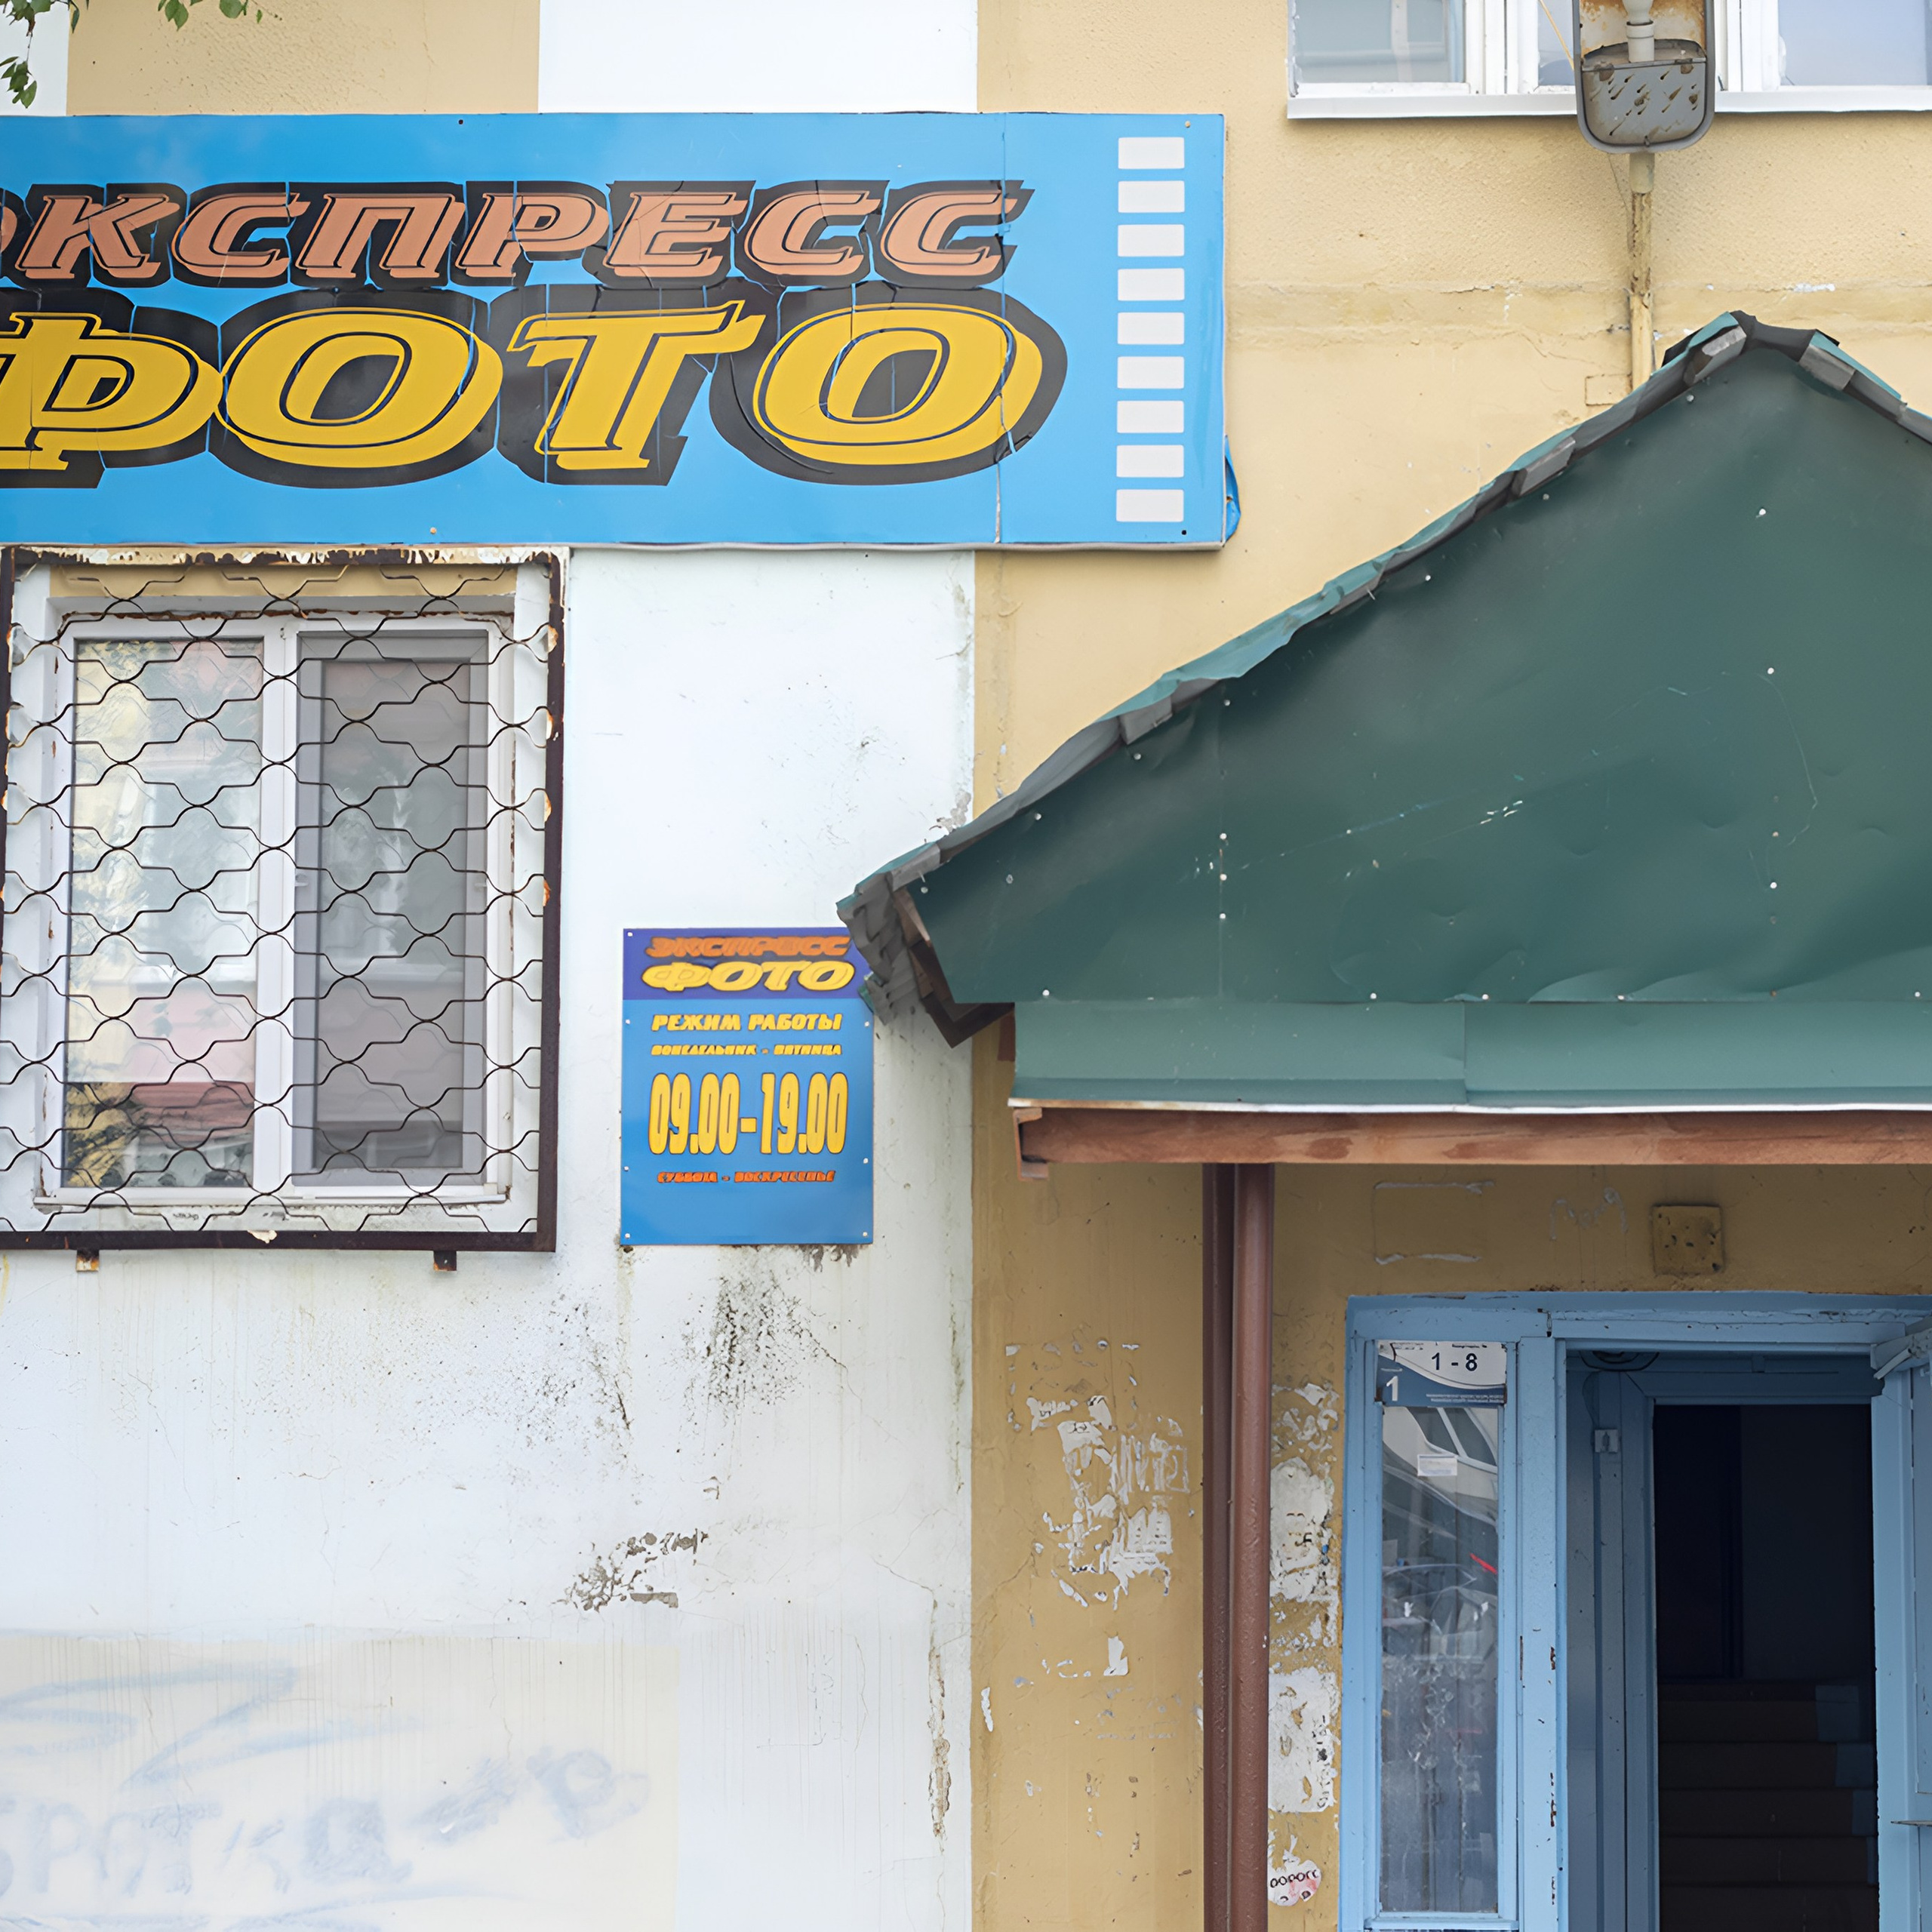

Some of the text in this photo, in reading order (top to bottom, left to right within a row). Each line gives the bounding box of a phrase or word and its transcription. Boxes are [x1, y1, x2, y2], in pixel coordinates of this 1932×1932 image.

[0, 190, 1019, 280] КСПРЕСС
[645, 935, 852, 958] ЭКСПРЕСС
[641, 961, 856, 992] ФОТО
[651, 1013, 843, 1032] РЕЖИМ РАБОТЫ
[648, 1072, 848, 1155] 09.00-19.00
[1431, 1352, 1441, 1371] 1
[1465, 1352, 1478, 1372] 8
[1386, 1375, 1399, 1402] 1
